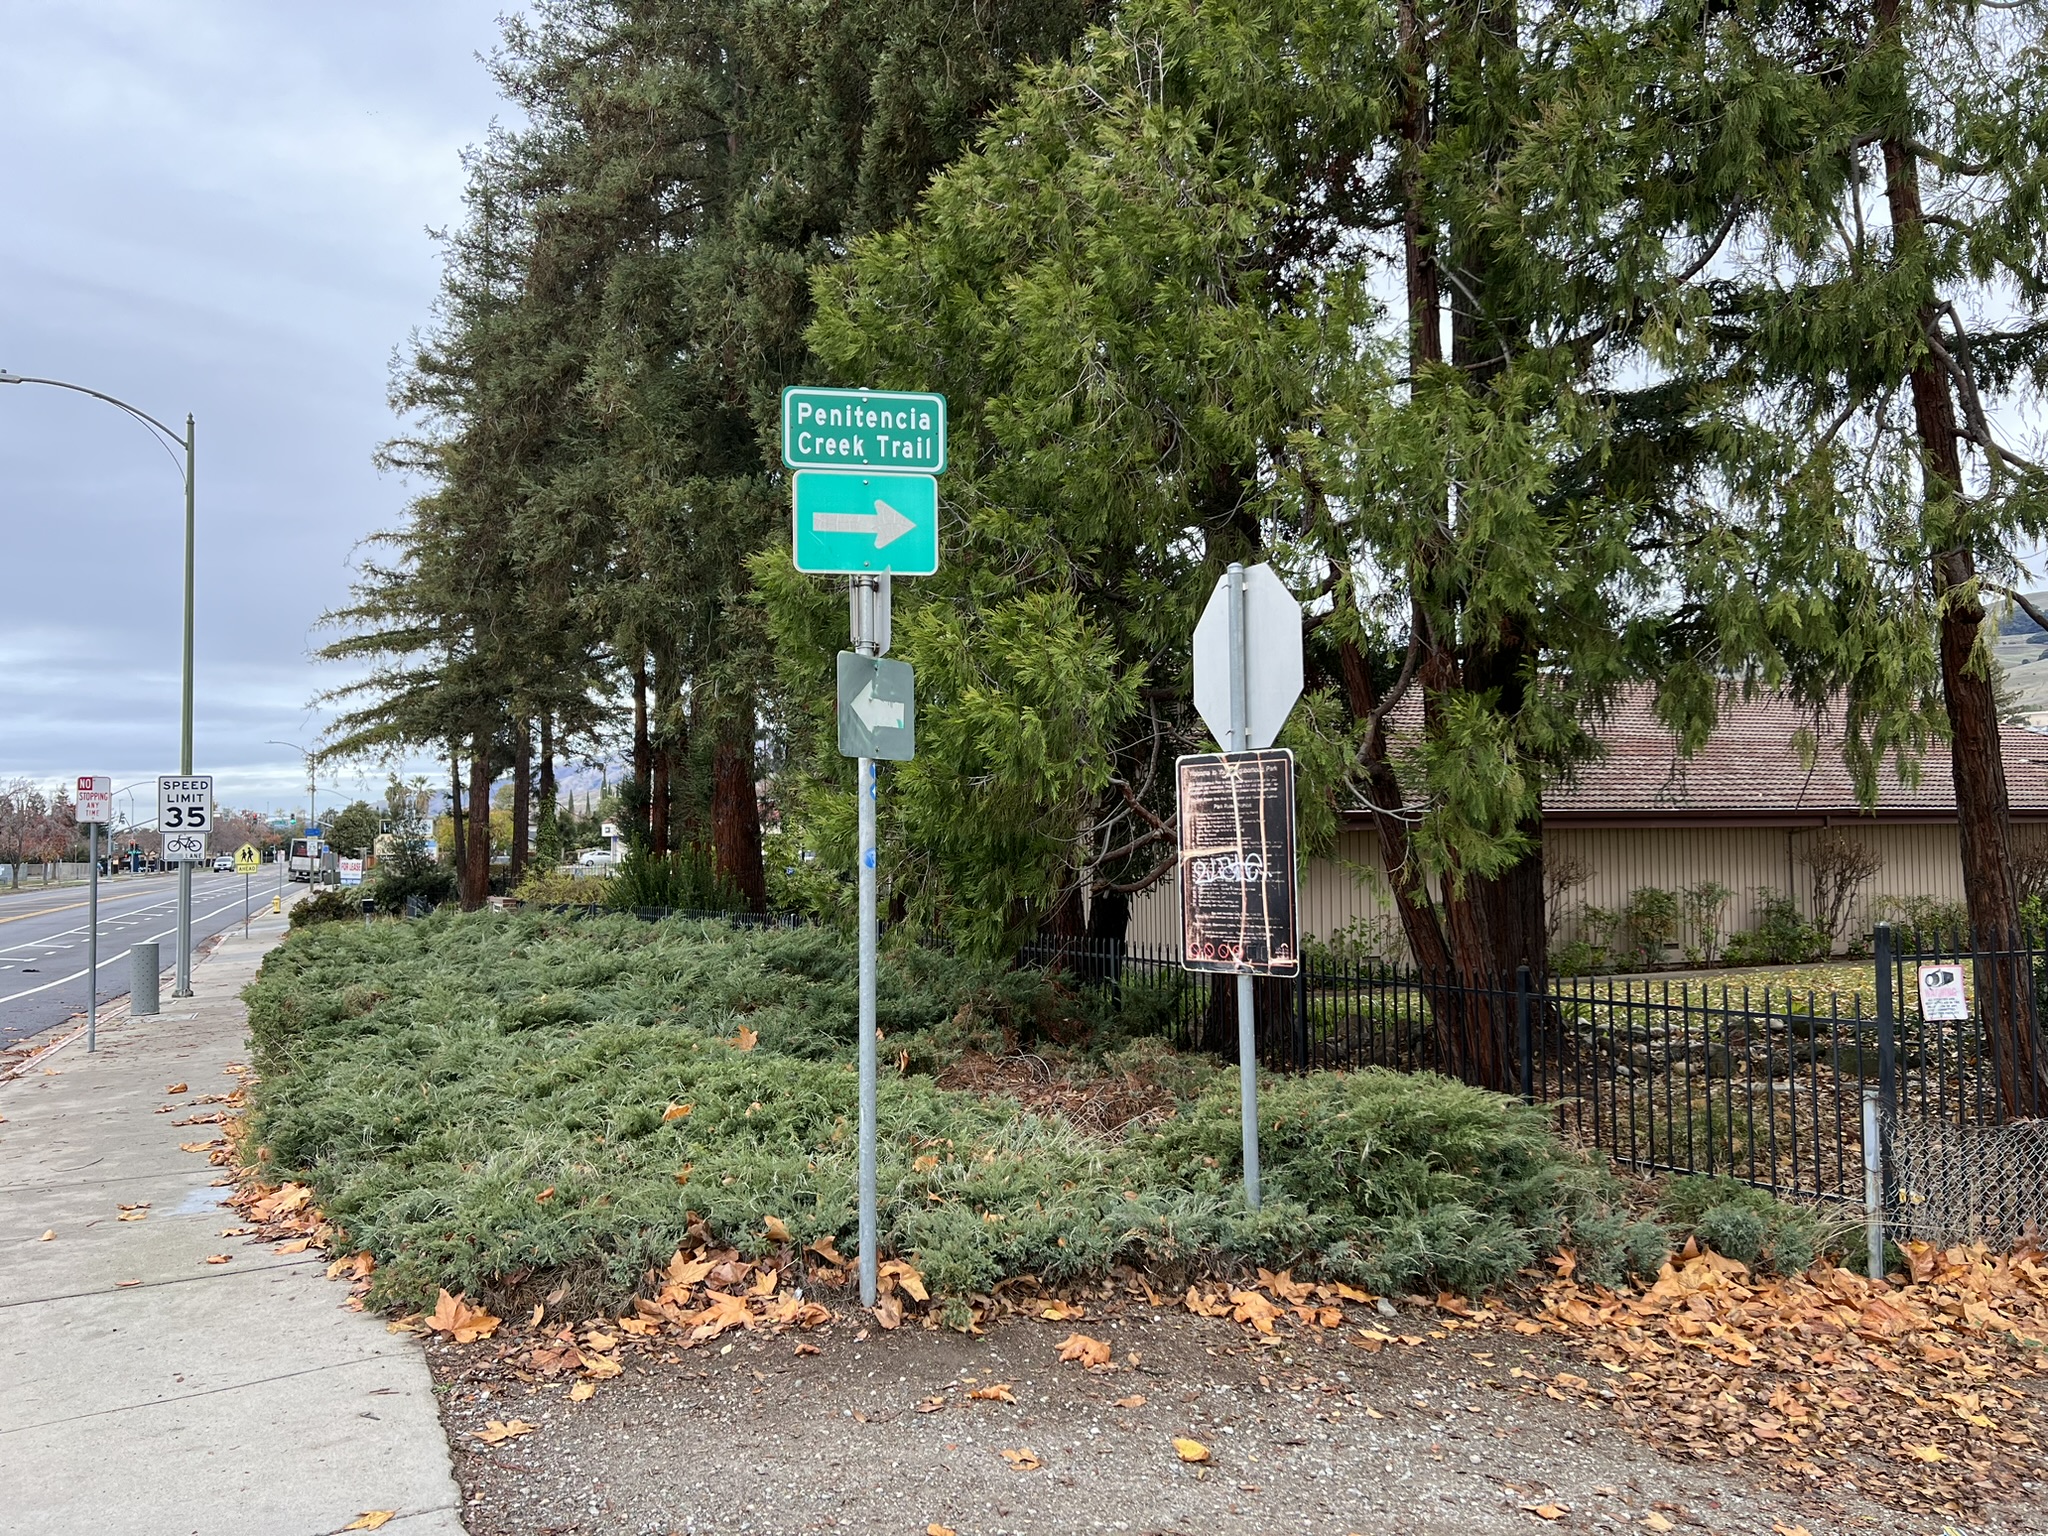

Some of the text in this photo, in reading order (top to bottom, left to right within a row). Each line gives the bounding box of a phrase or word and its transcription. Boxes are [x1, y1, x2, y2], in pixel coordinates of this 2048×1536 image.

[797, 402, 931, 431] Penitencia
[797, 432, 932, 460] Creek Trail
[79, 778, 91, 789] NO
[163, 781, 209, 790] SPEED
[79, 792, 108, 801] STOPPING
[167, 793, 204, 803] LIMIT
[85, 809, 100, 817] TIME
[164, 806, 206, 828] 35
[341, 862, 361, 872] FOR LEASE
